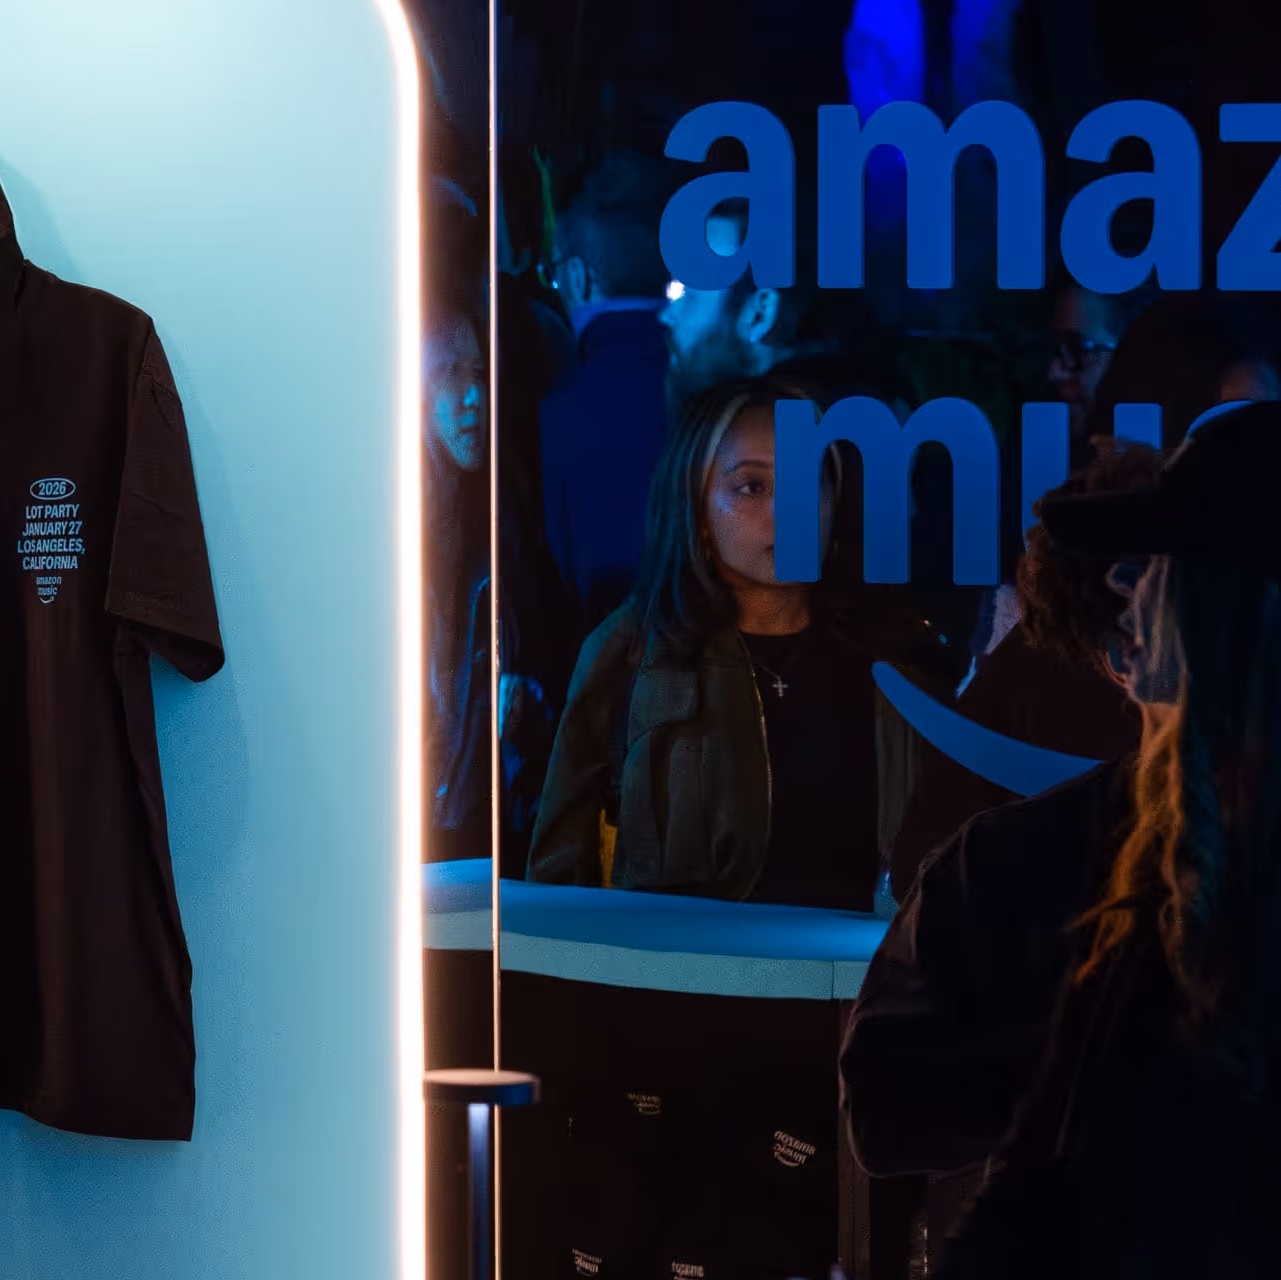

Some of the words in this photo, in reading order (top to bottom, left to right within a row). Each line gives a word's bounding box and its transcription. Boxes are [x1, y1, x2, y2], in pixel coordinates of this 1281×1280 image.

[38, 481, 67, 496] 2026
[25, 505, 44, 519] LOT
[44, 504, 80, 519] PARTY
[22, 521, 68, 536] JANUARY
[68, 520, 83, 535] 27
[17, 540, 37, 554] LOS
[36, 538, 86, 555] ANGELES,
[22, 555, 78, 570] CALIFORNIA
[35, 575, 62, 586] amazon
[37, 586, 58, 596] music
